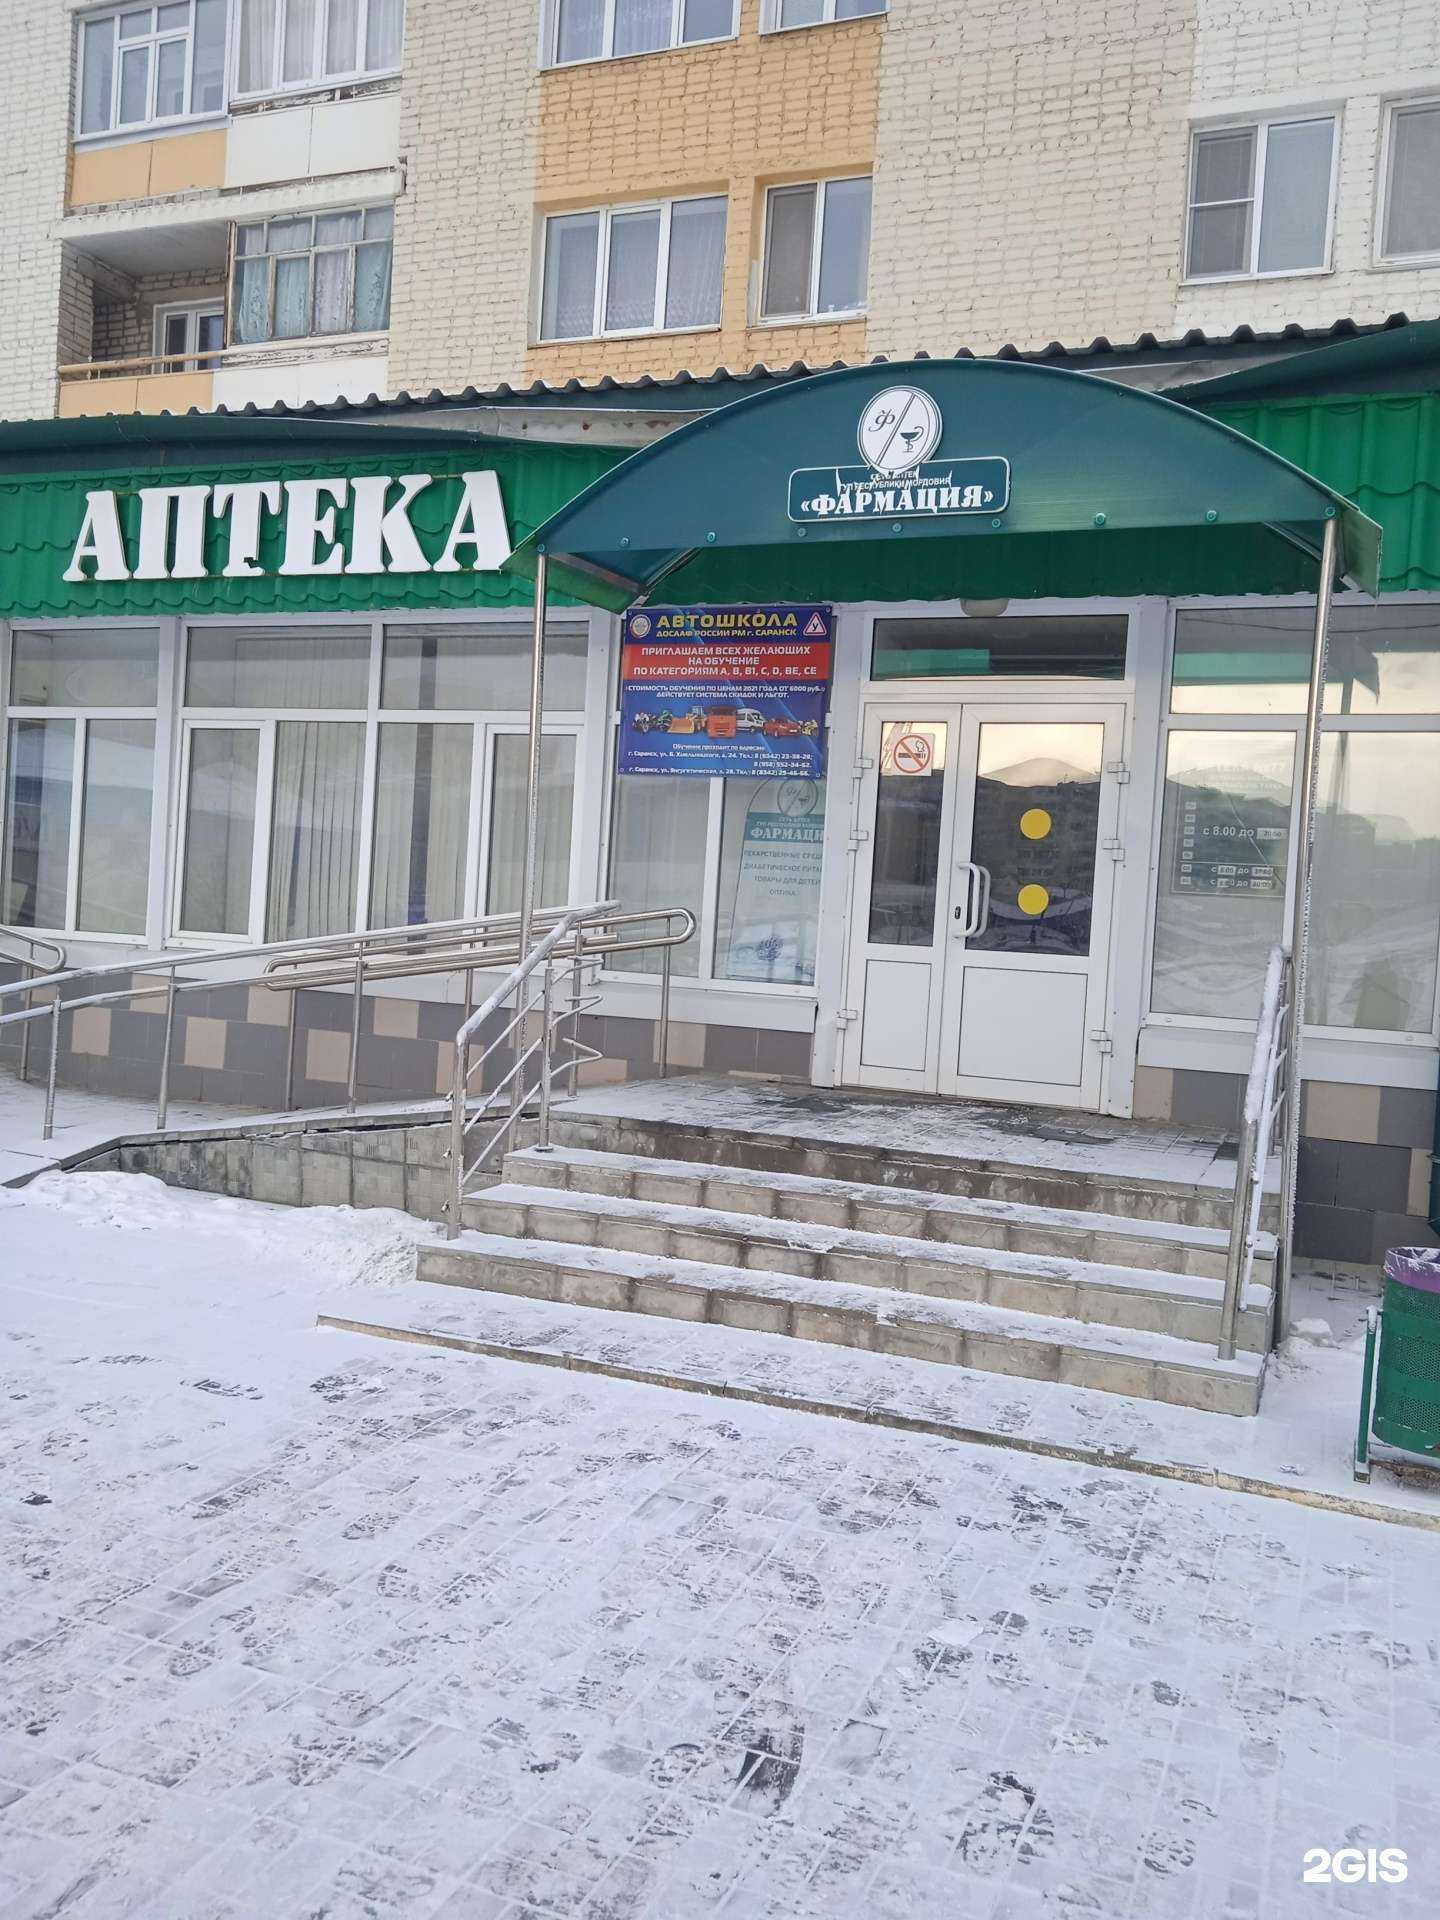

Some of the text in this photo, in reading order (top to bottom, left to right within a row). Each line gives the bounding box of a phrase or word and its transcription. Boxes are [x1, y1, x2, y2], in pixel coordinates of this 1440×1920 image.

[800, 485, 994, 515] «ФАРМАЦИЯ»
[62, 470, 512, 582] АПТЕКА
[656, 613, 798, 628] АВТОШКОЛА
[694, 630, 730, 638] РОССИИ
[731, 629, 746, 637] РМ
[755, 628, 797, 637] САРАНСК
[641, 646, 811, 656] ПРИГЛАШАЕМ ВСЕХ ЖЕЛАЮЩИХ
[688, 656, 760, 665] НА ОБУЧЕНИЕ
[633, 667, 648, 675] ПО
[649, 667, 719, 676] КАТЕГОРИЯМ
[1238, 828, 1255, 838] до
